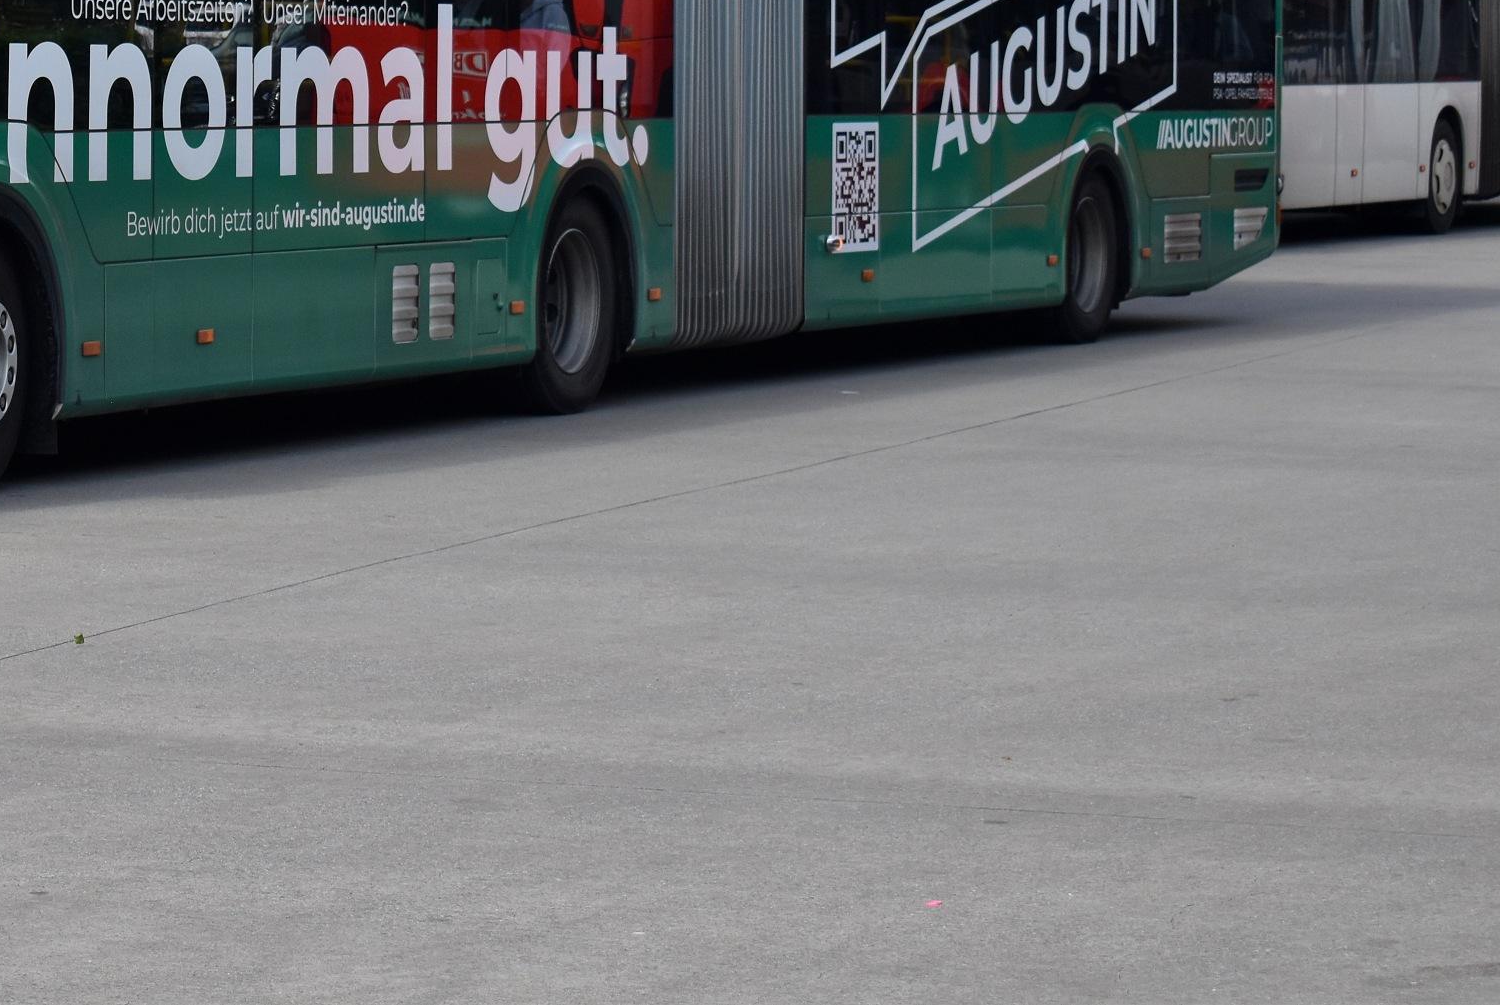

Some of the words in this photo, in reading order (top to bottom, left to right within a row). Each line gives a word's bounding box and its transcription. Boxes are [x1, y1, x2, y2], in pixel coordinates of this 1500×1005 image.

[485, 26, 649, 213] gut.
[127, 209, 181, 237] Bewirb
[184, 205, 216, 235] dich
[217, 205, 253, 239] jetzt
[255, 204, 280, 230] auf
[282, 197, 426, 231] wir-sind-augustin.de
